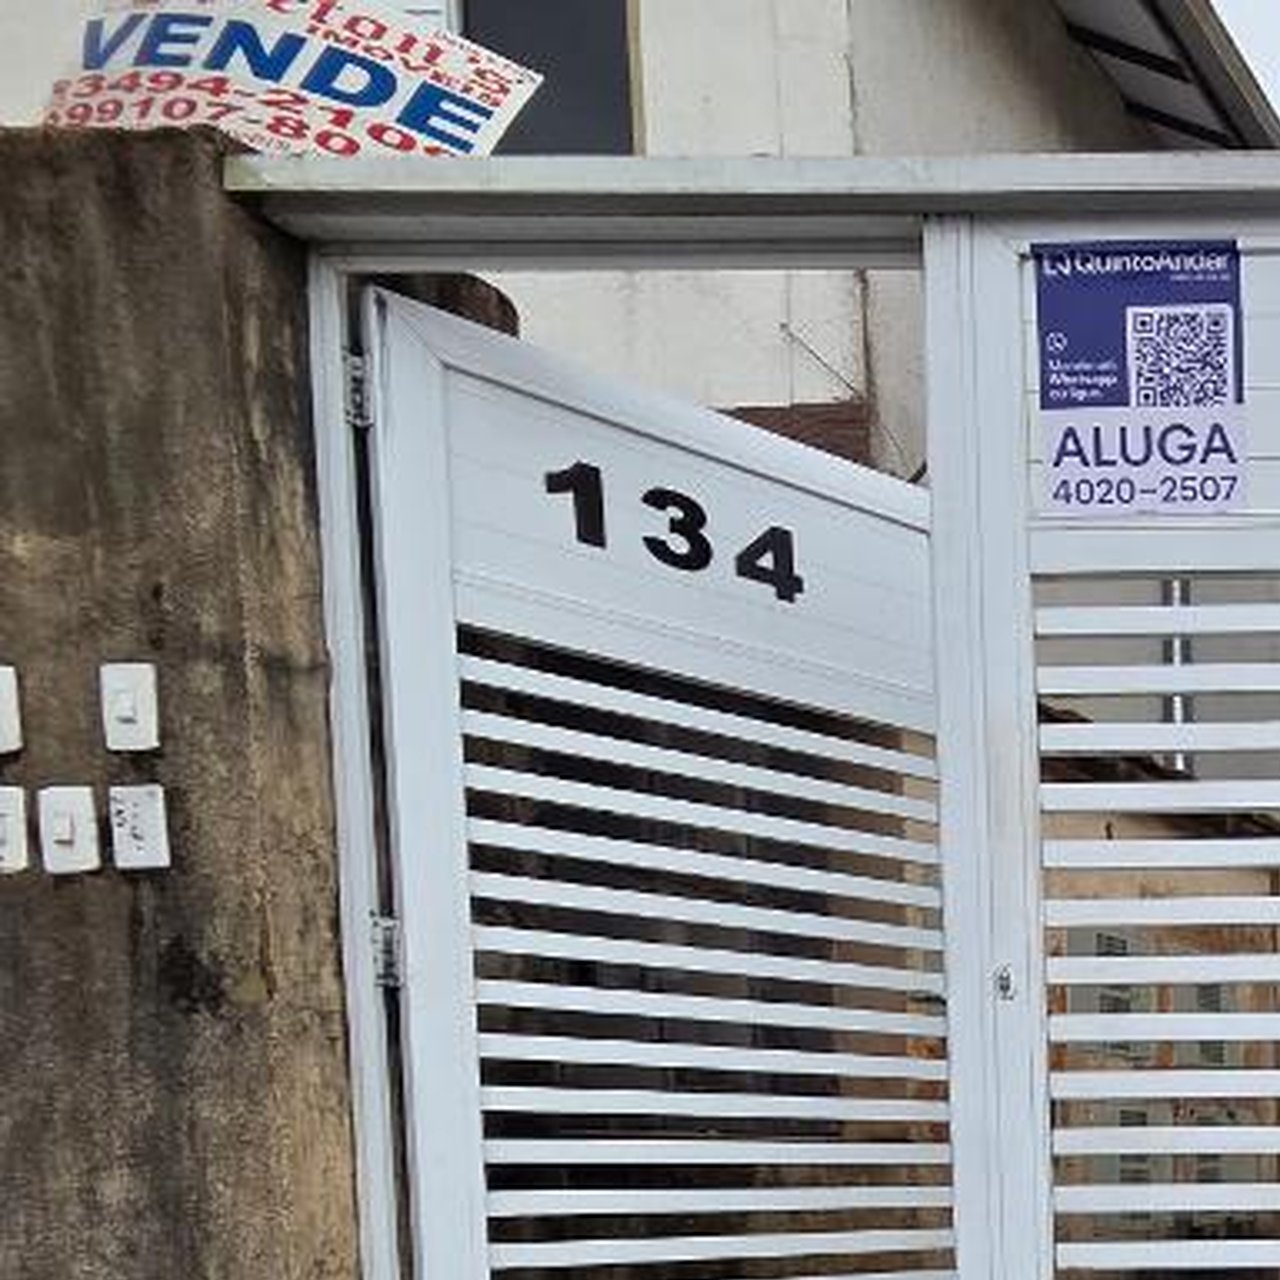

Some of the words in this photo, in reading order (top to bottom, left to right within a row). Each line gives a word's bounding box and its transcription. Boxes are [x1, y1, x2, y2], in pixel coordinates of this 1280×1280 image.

[82, 13, 495, 154] VENDE
[1052, 476, 1238, 505] 4020-2507
[1053, 422, 1237, 468] ALUGA
[545, 461, 805, 603] 134
